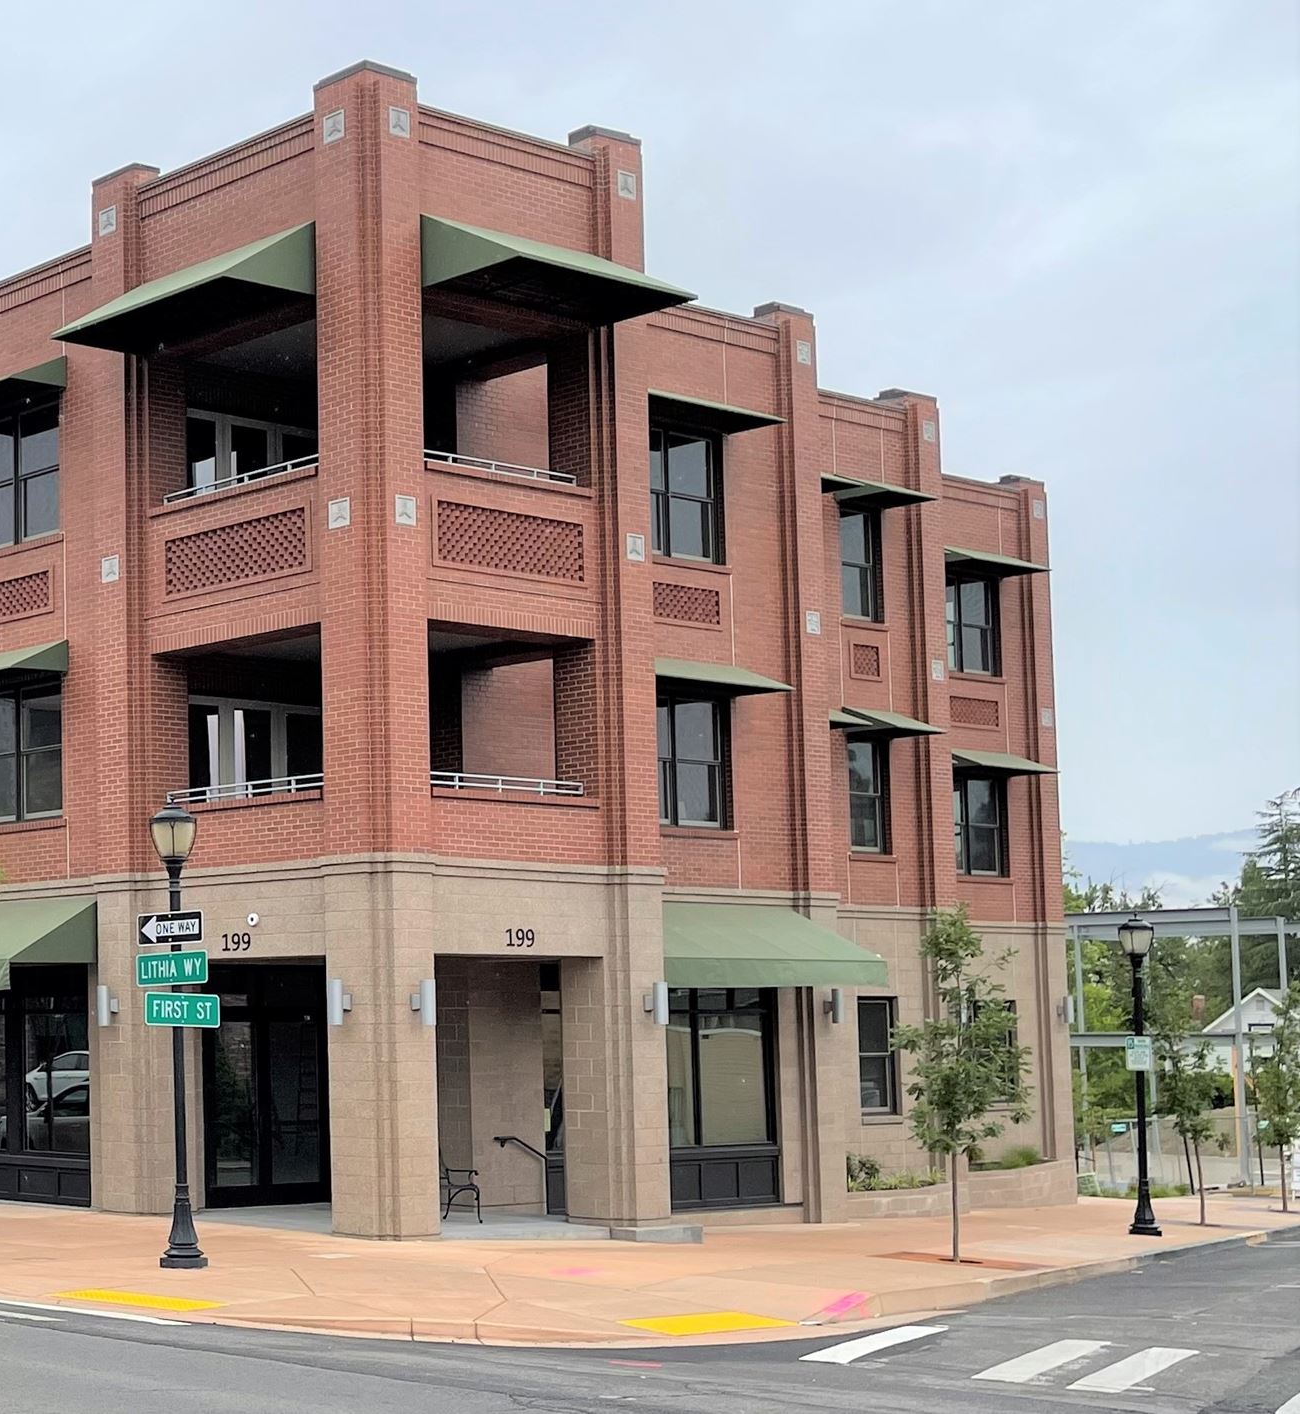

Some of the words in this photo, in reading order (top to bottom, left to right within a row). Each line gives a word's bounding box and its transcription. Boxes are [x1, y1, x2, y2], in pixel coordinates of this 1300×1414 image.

[156, 922, 175, 935] ONE
[178, 920, 197, 932] WAY
[221, 932, 251, 951] 199
[505, 928, 535, 948] 199
[141, 960, 178, 979] LITHIA
[183, 958, 202, 977] WY
[153, 1000, 189, 1019] FIRST
[196, 1002, 212, 1020] ST
